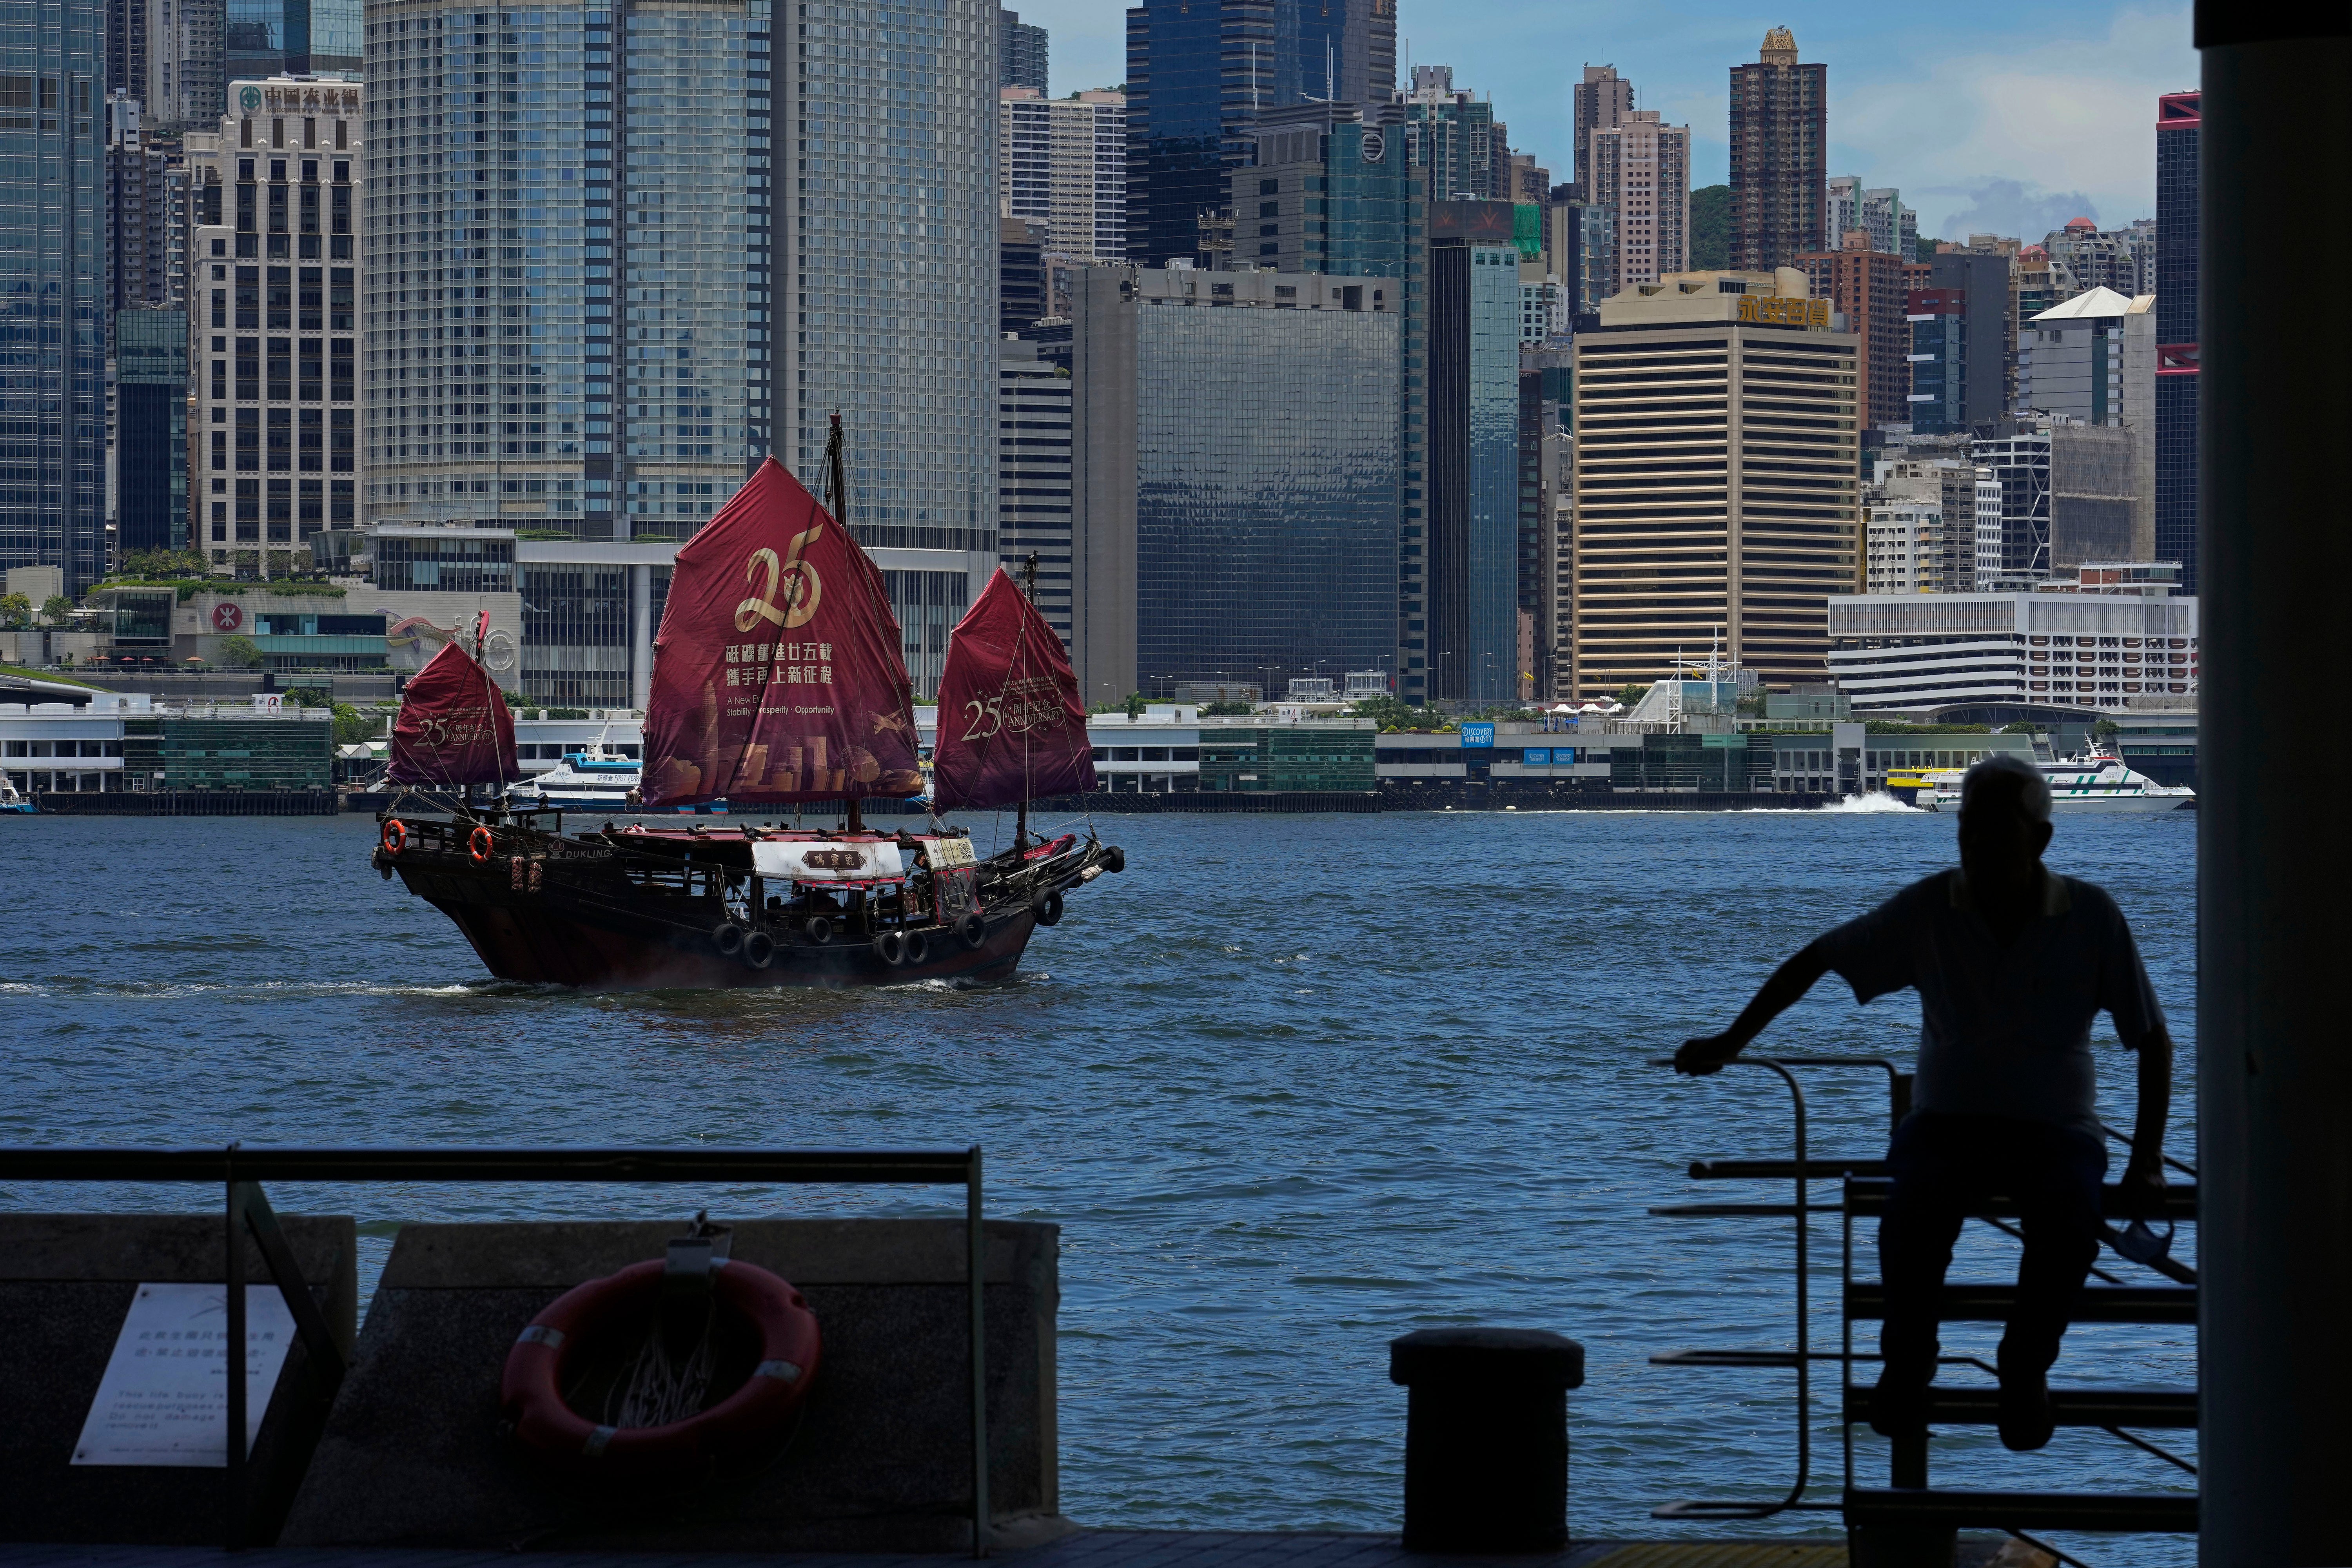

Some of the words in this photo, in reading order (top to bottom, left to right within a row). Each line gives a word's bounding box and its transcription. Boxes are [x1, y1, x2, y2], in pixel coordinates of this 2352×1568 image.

[265, 87, 363, 105] 中国农业银
[1738, 294, 1828, 326] 永安百貨
[726, 666, 833, 686] 攜手再上新征程
[727, 697, 733, 706] A
[734, 696, 751, 705] New
[1013, 699, 1051, 715] 周年紀念
[727, 708, 751, 717] Stability
[755, 705, 789, 715] rosperity
[794, 705, 835, 715] Opportunity
[961, 696, 1003, 742] 25
[1008, 710, 1063, 728] ANNIVERSARY
[413, 718, 448, 746] 25
[455, 723, 484, 733] 周年紀念
[1462, 727, 1493, 737] DISCOVERY
[450, 732, 491, 742] ANNIVERSARY
[1480, 735, 1493, 744] BAY
[566, 849, 611, 858] DUKLING
[814, 853, 855, 866] 鴨靈號
[119, 1390, 143, 1399] This
[165, 1413, 215, 1422] damage
